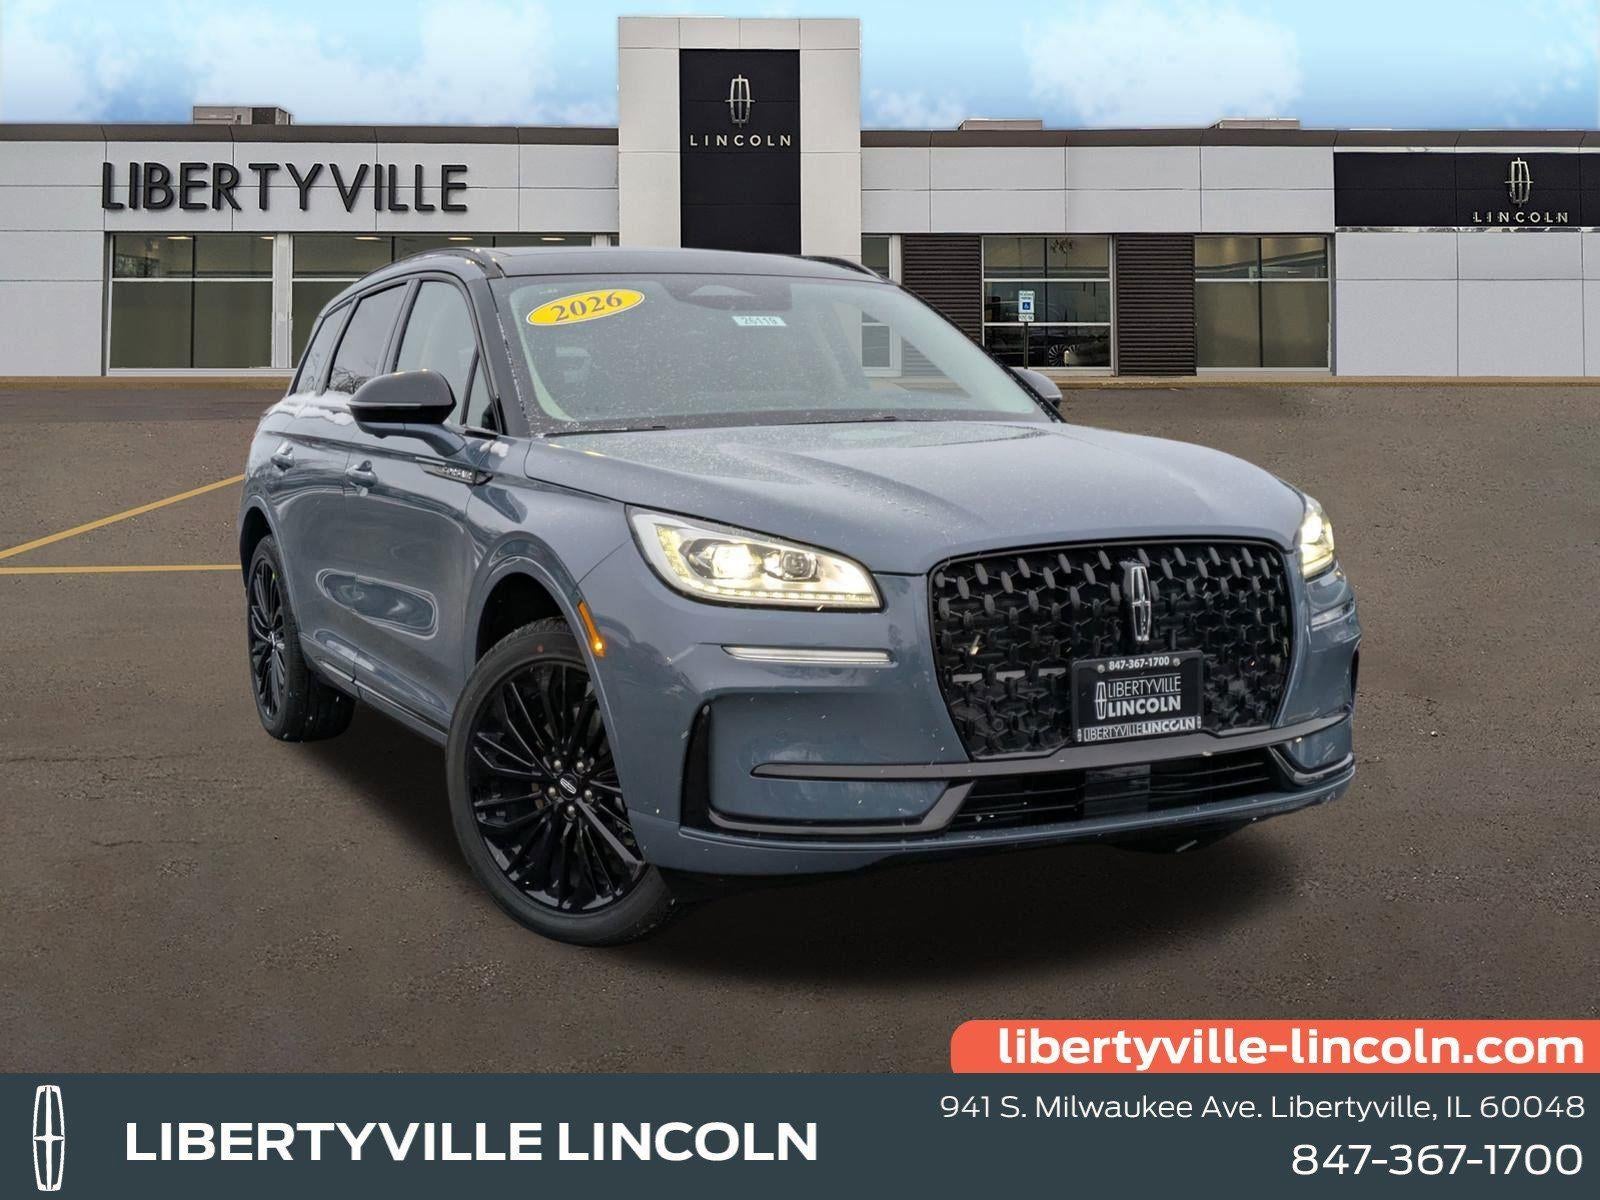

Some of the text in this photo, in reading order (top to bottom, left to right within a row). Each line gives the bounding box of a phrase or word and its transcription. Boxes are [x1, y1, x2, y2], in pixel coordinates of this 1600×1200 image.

[690, 134, 791, 147] LINCOLN
[102, 162, 468, 213] LIBERTYVILLE
[1474, 211, 1568, 223] LINCOLN
[551, 291, 623, 321] 2026
[1108, 656, 1170, 671] 847-367-1700
[1108, 676, 1181, 698] LIBERTYVILLE
[1108, 695, 1181, 718] LINCOLN
